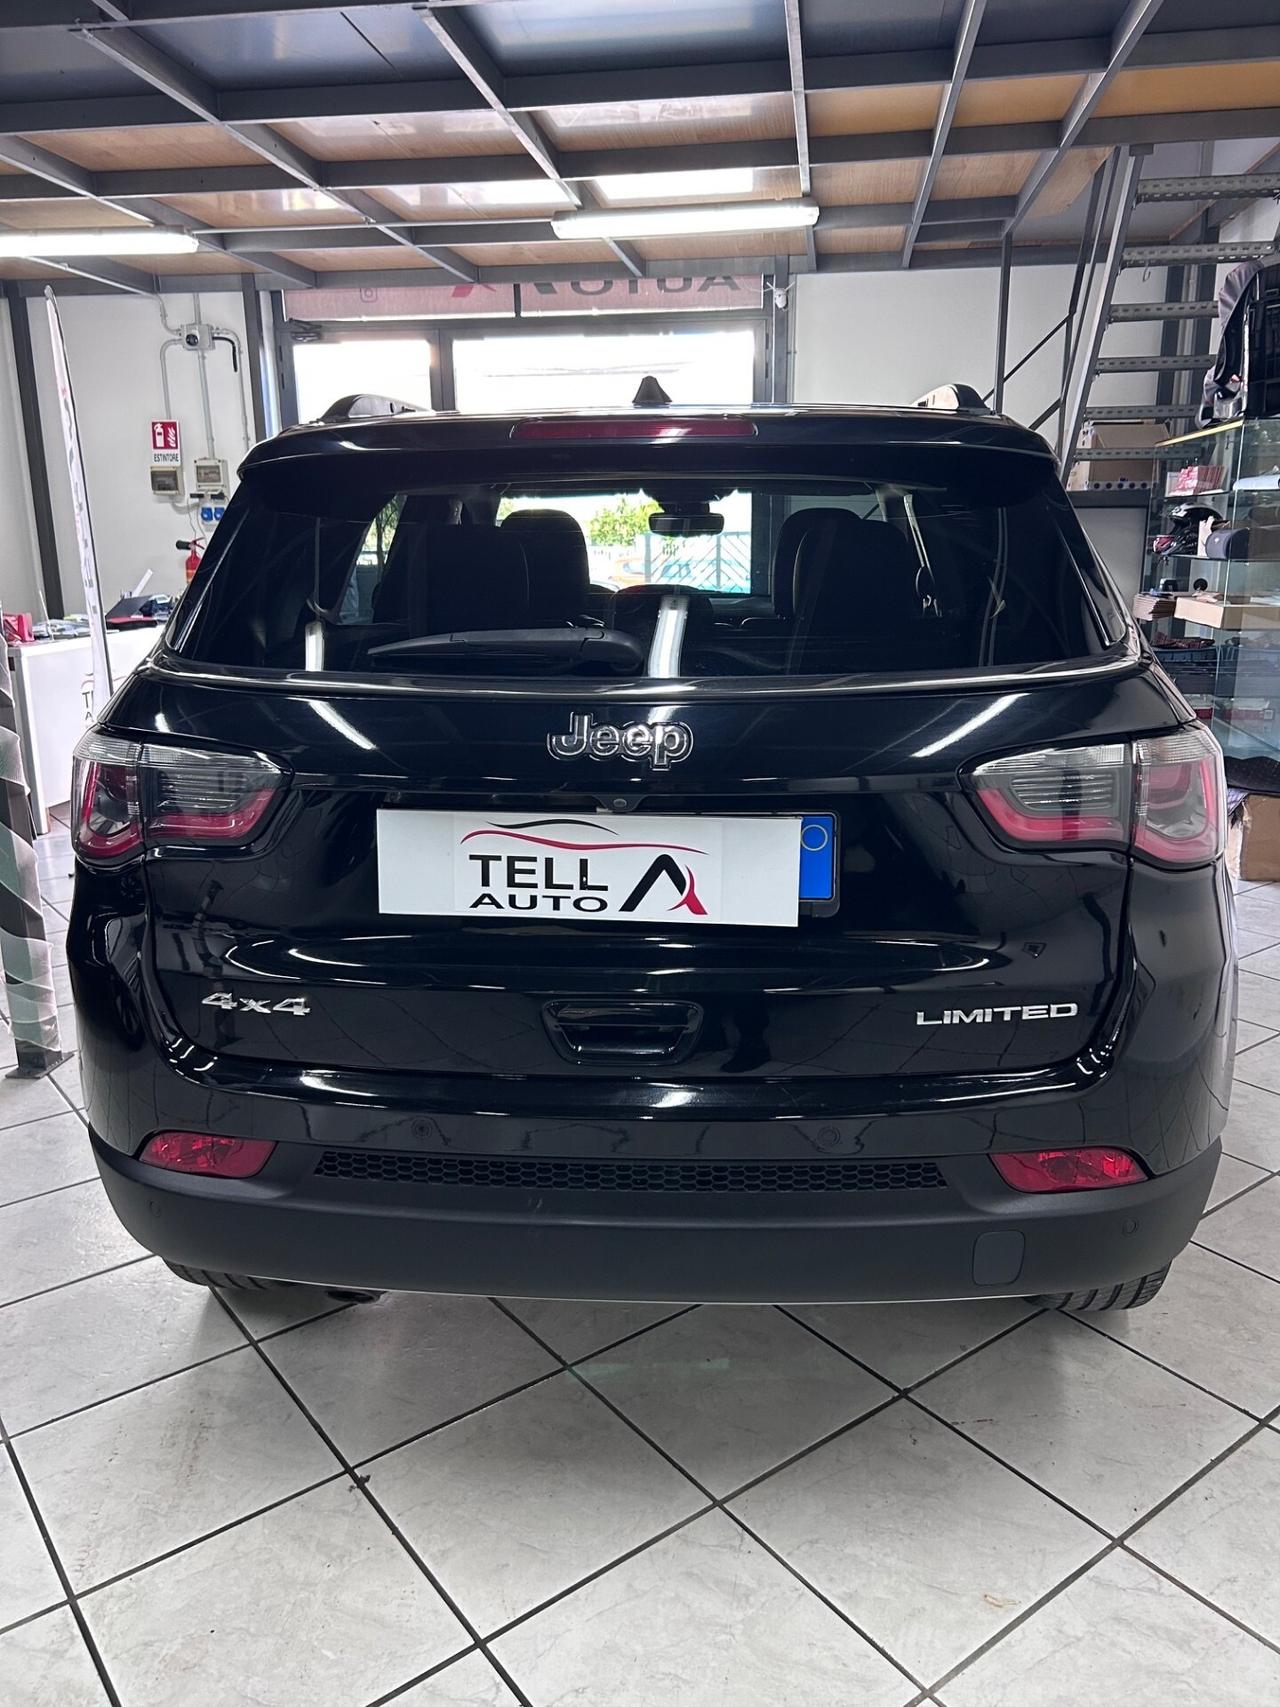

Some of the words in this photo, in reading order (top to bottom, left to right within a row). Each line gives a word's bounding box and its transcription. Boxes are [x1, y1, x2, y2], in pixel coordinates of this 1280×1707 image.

[153, 453, 179, 463] ESTINTORE
[548, 712, 693, 770] Jeep
[469, 854, 609, 892] TELL
[469, 893, 609, 913] AUTO
[201, 992, 311, 1016] 4x4
[916, 1002, 1078, 1026] LIMITED
